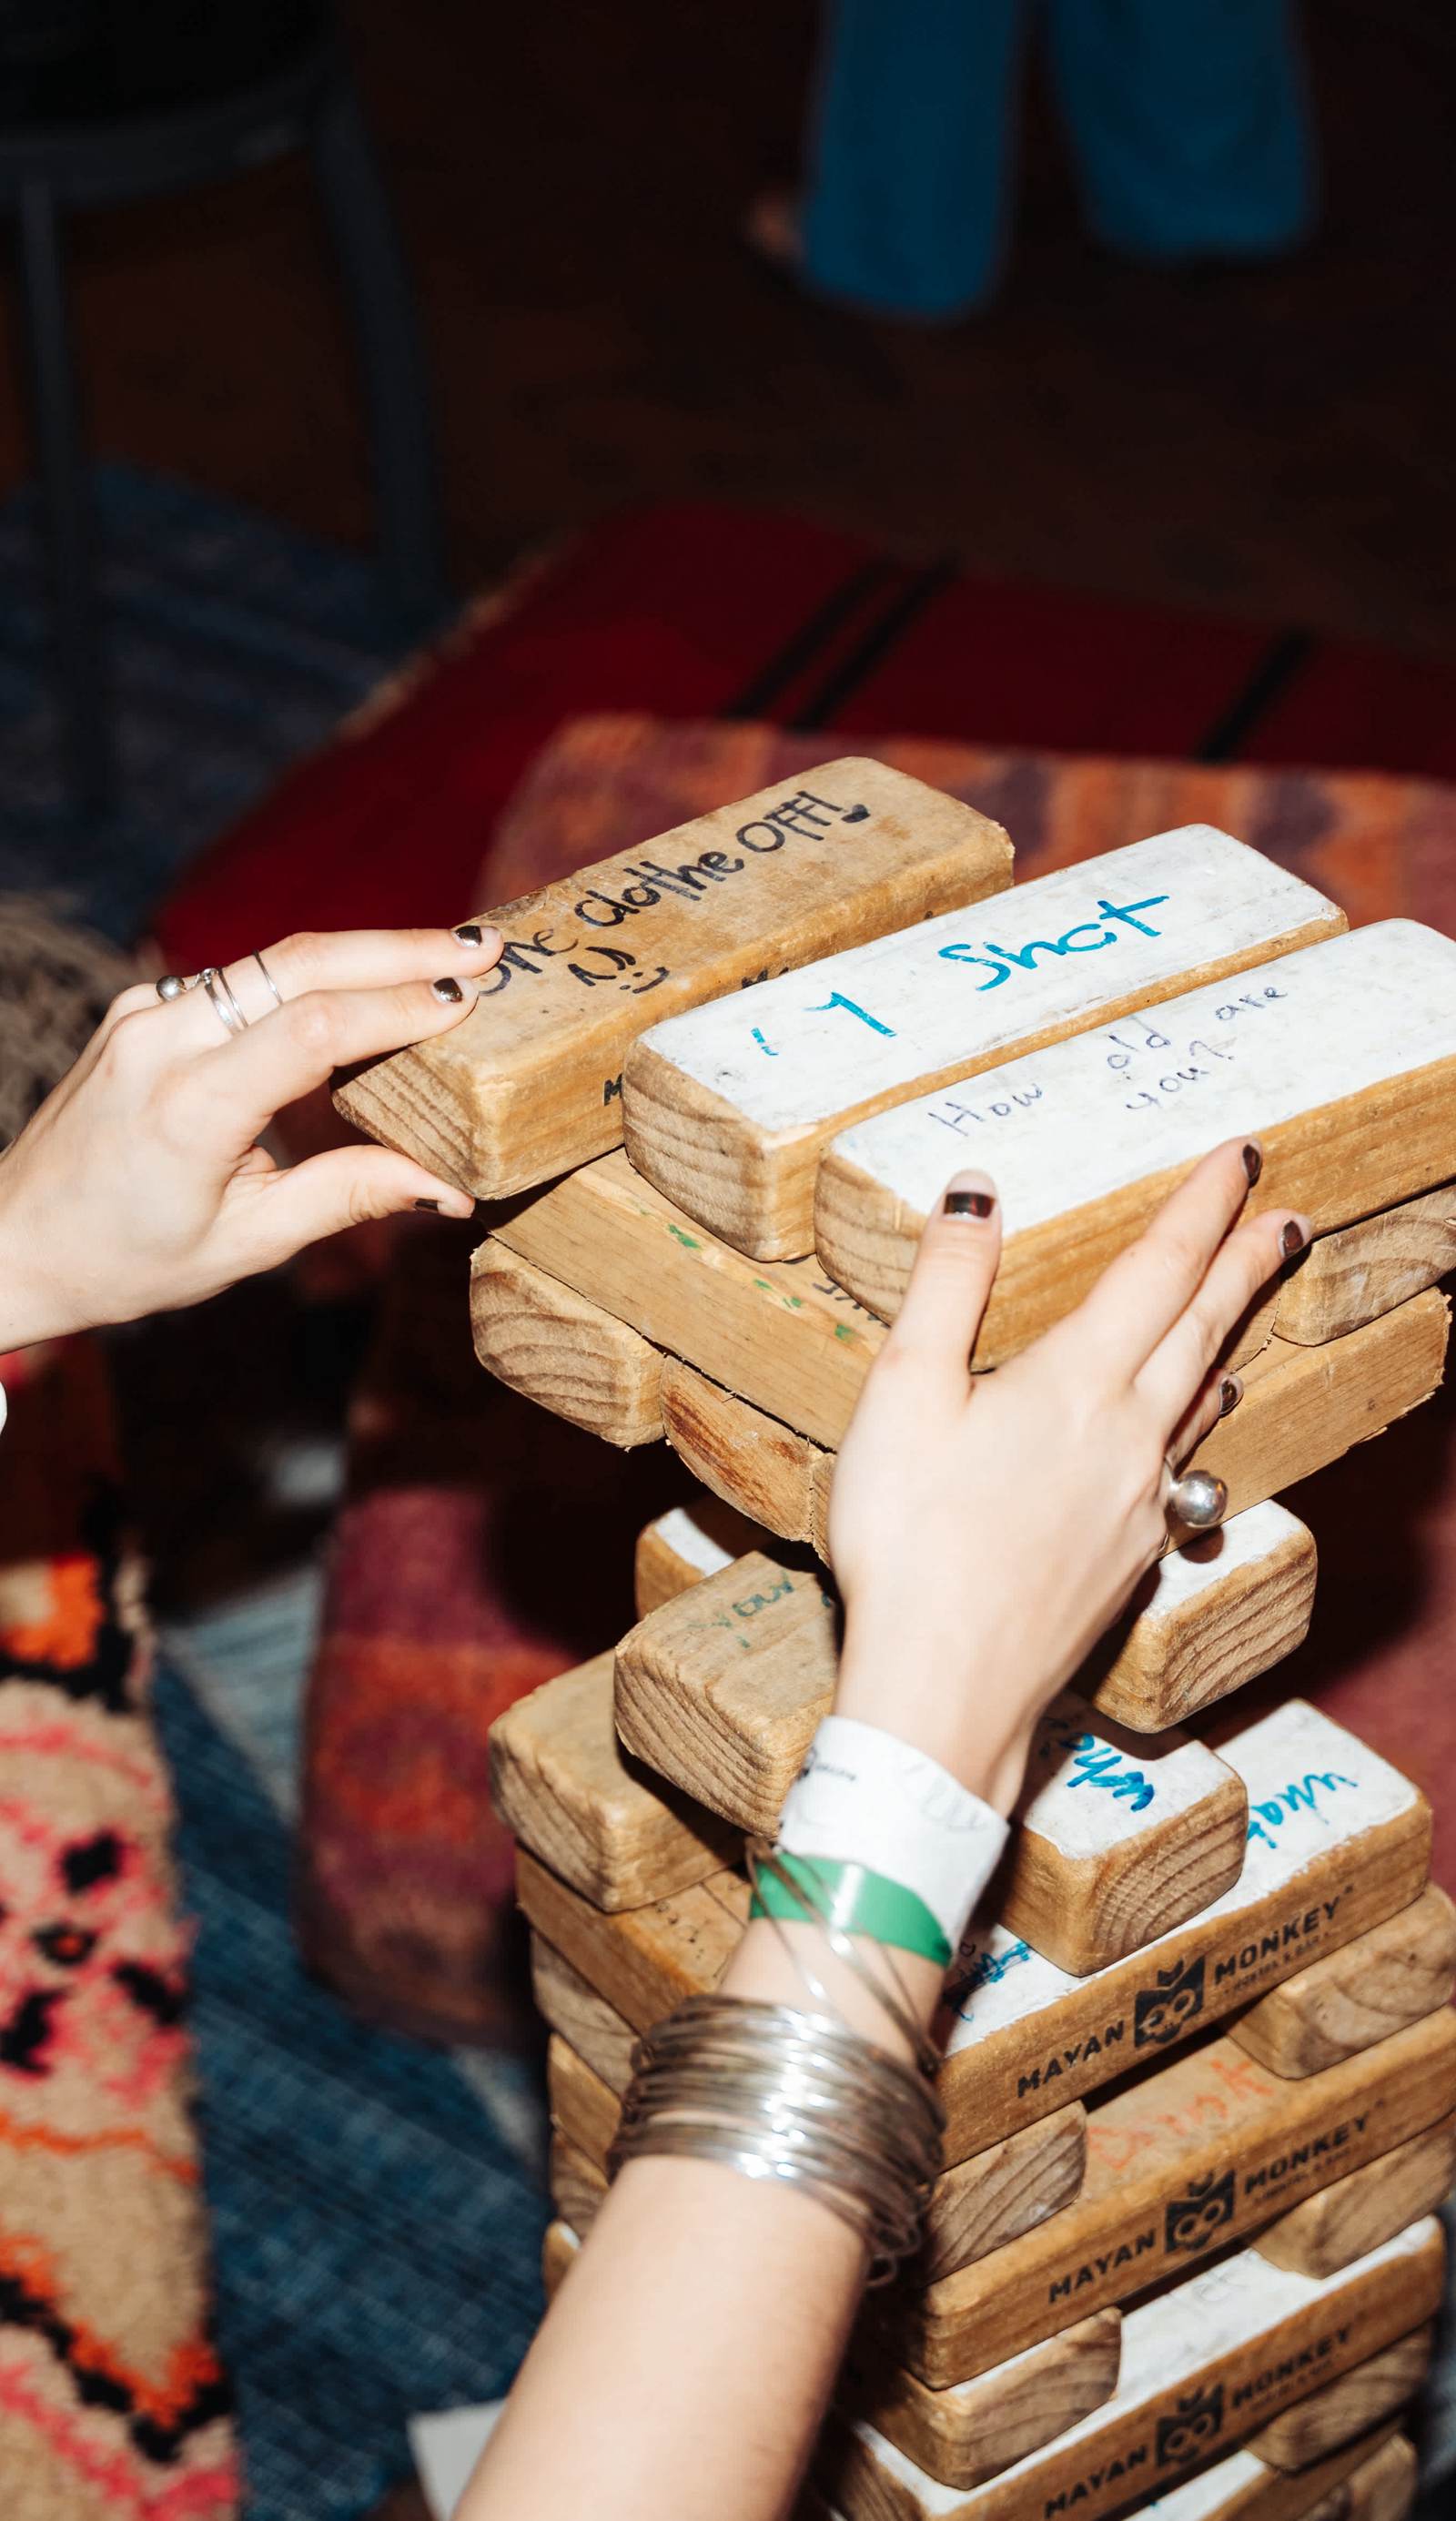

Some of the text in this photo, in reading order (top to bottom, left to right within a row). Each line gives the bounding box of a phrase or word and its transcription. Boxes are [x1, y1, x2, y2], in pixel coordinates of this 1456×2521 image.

[928, 987, 1288, 1137] How old are
[1016, 2020, 1125, 2099] MAYAN
[1214, 1894, 1340, 1986] MONKEY
[1048, 2229, 1157, 2303] MAYAN
[1244, 2111, 1370, 2195] MONKEY
[1044, 2444, 1148, 2520] MAYAN
[1232, 2323, 1352, 2409] MONKEY
